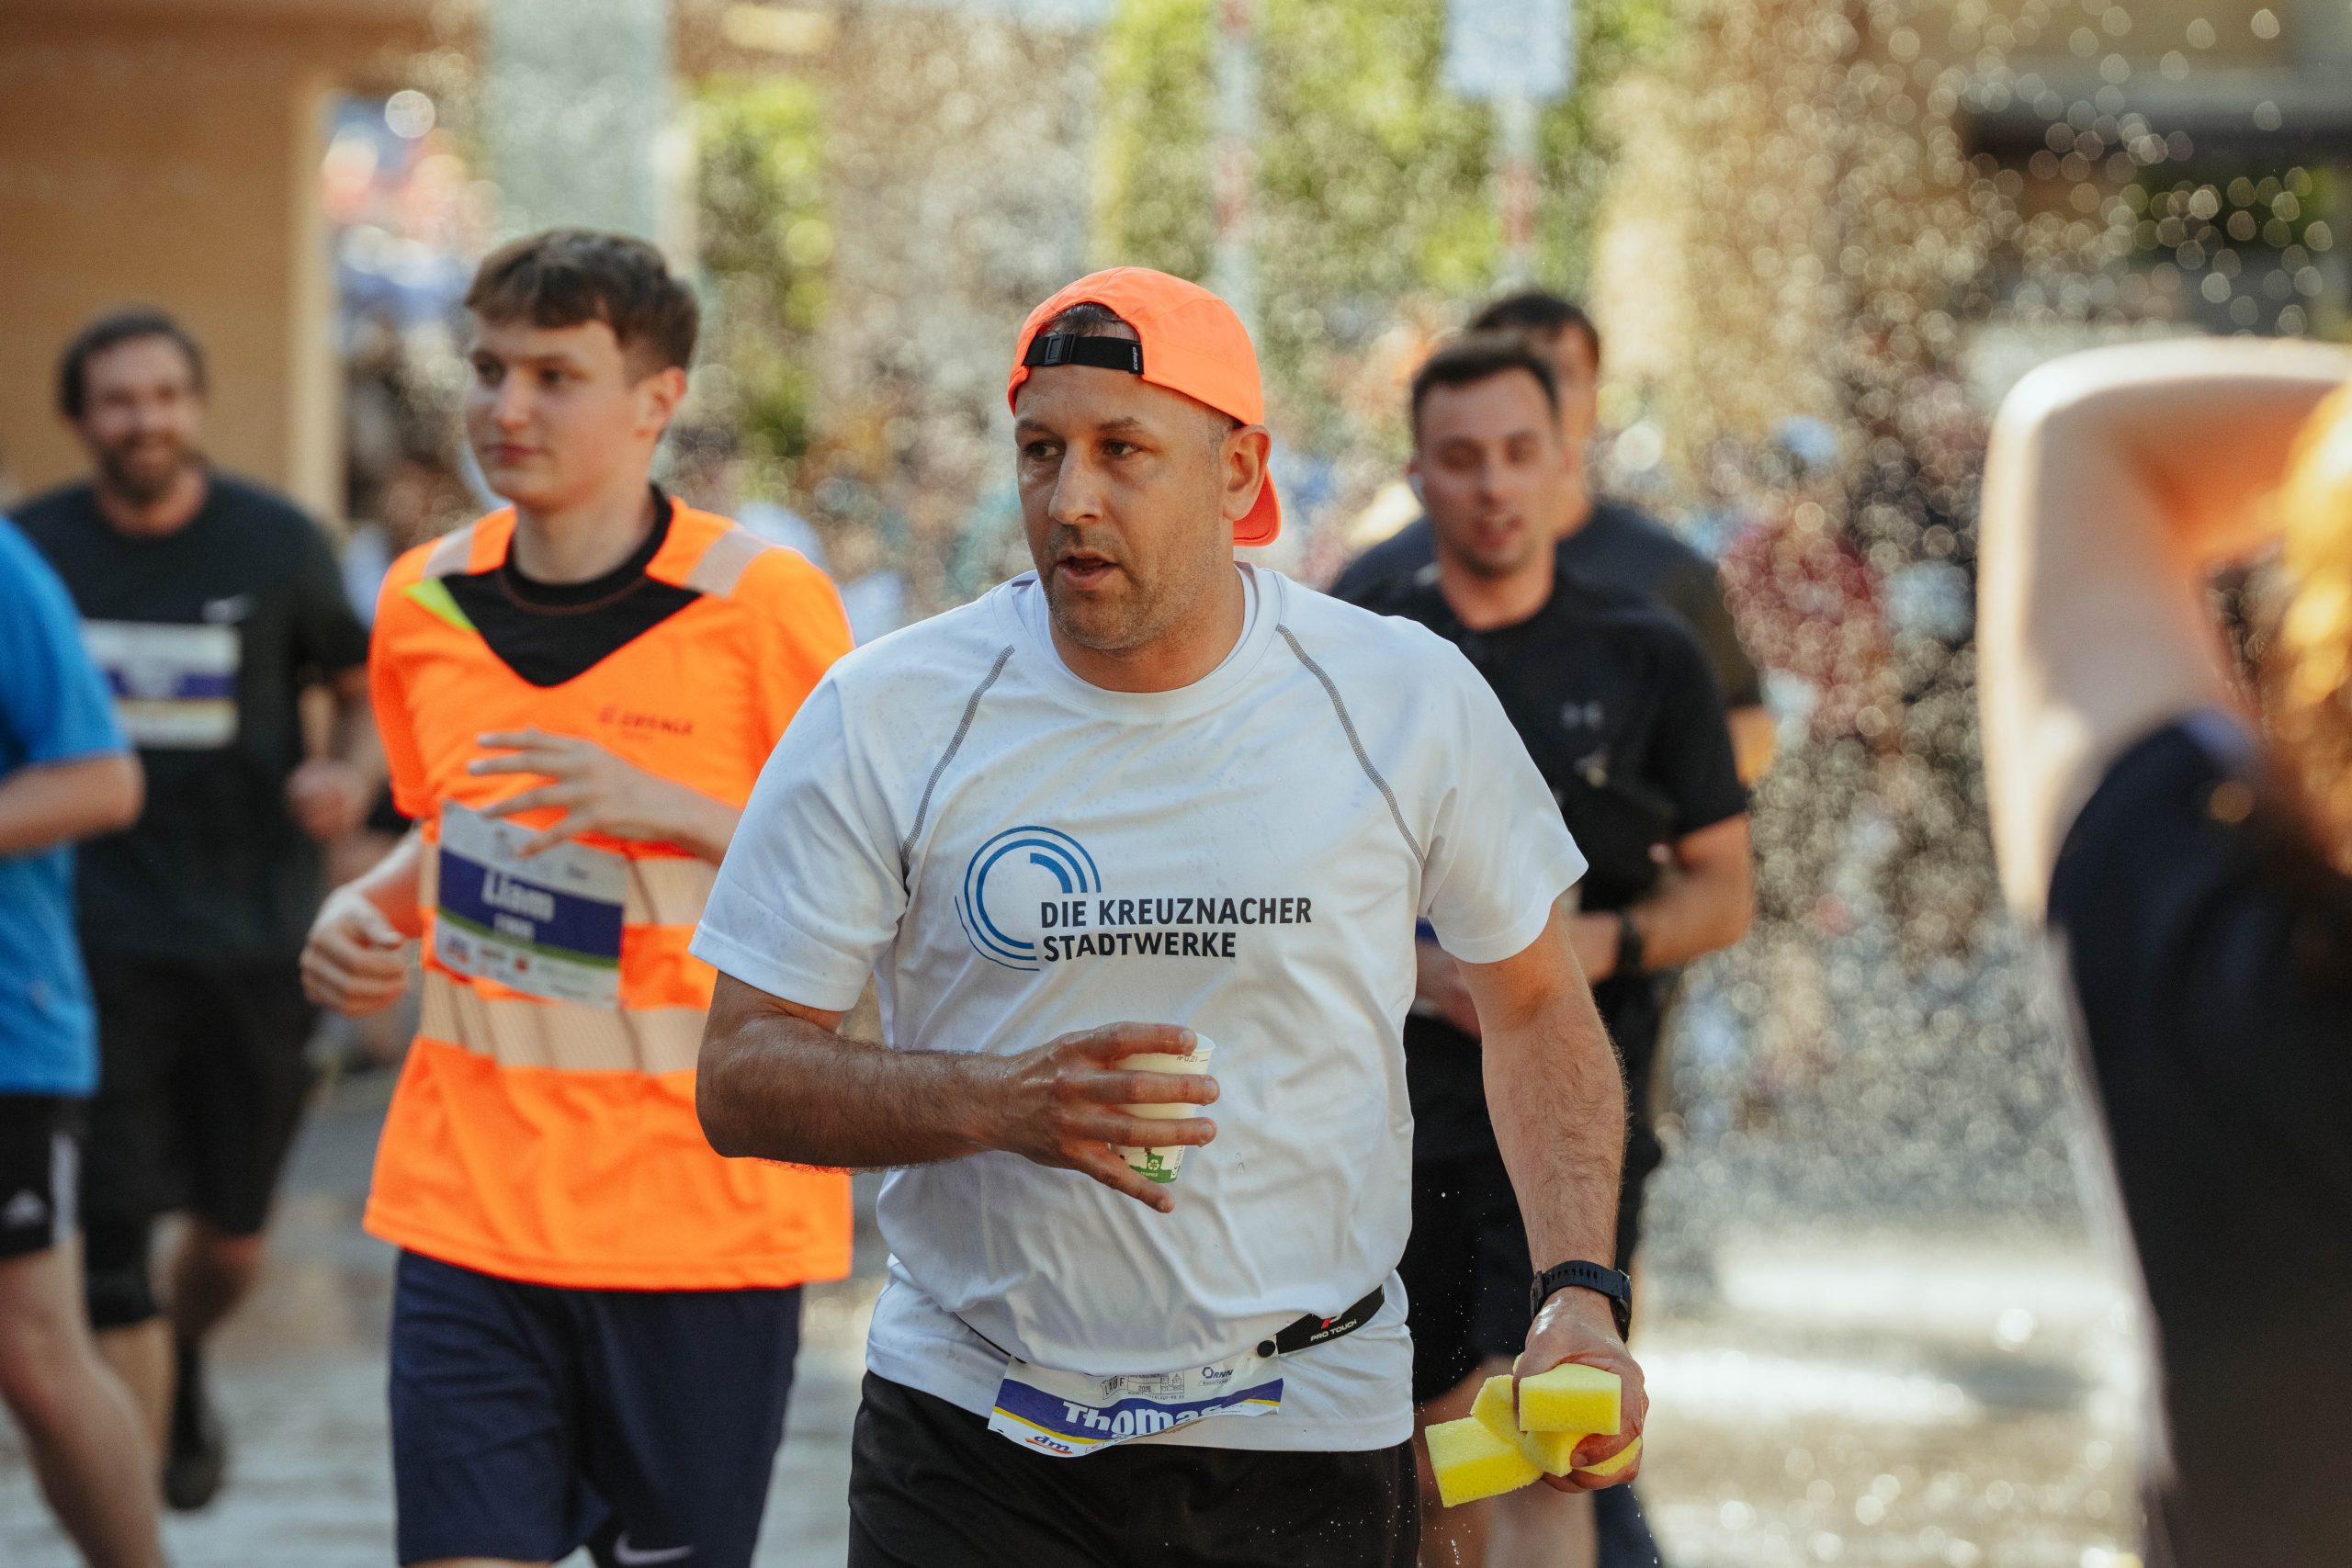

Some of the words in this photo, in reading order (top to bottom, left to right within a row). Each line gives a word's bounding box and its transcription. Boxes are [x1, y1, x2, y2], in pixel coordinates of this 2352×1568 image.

[1041, 900, 1087, 928] DIE
[1098, 897, 1312, 926] KREUZNACHER
[1043, 931, 1237, 963] STADTWERKE
[1310, 1331, 1329, 1341] PRO
[1329, 1319, 1357, 1335] TOUCH
[1105, 1377, 1125, 1395] LAUF
[1034, 1435, 1070, 1451] dm
